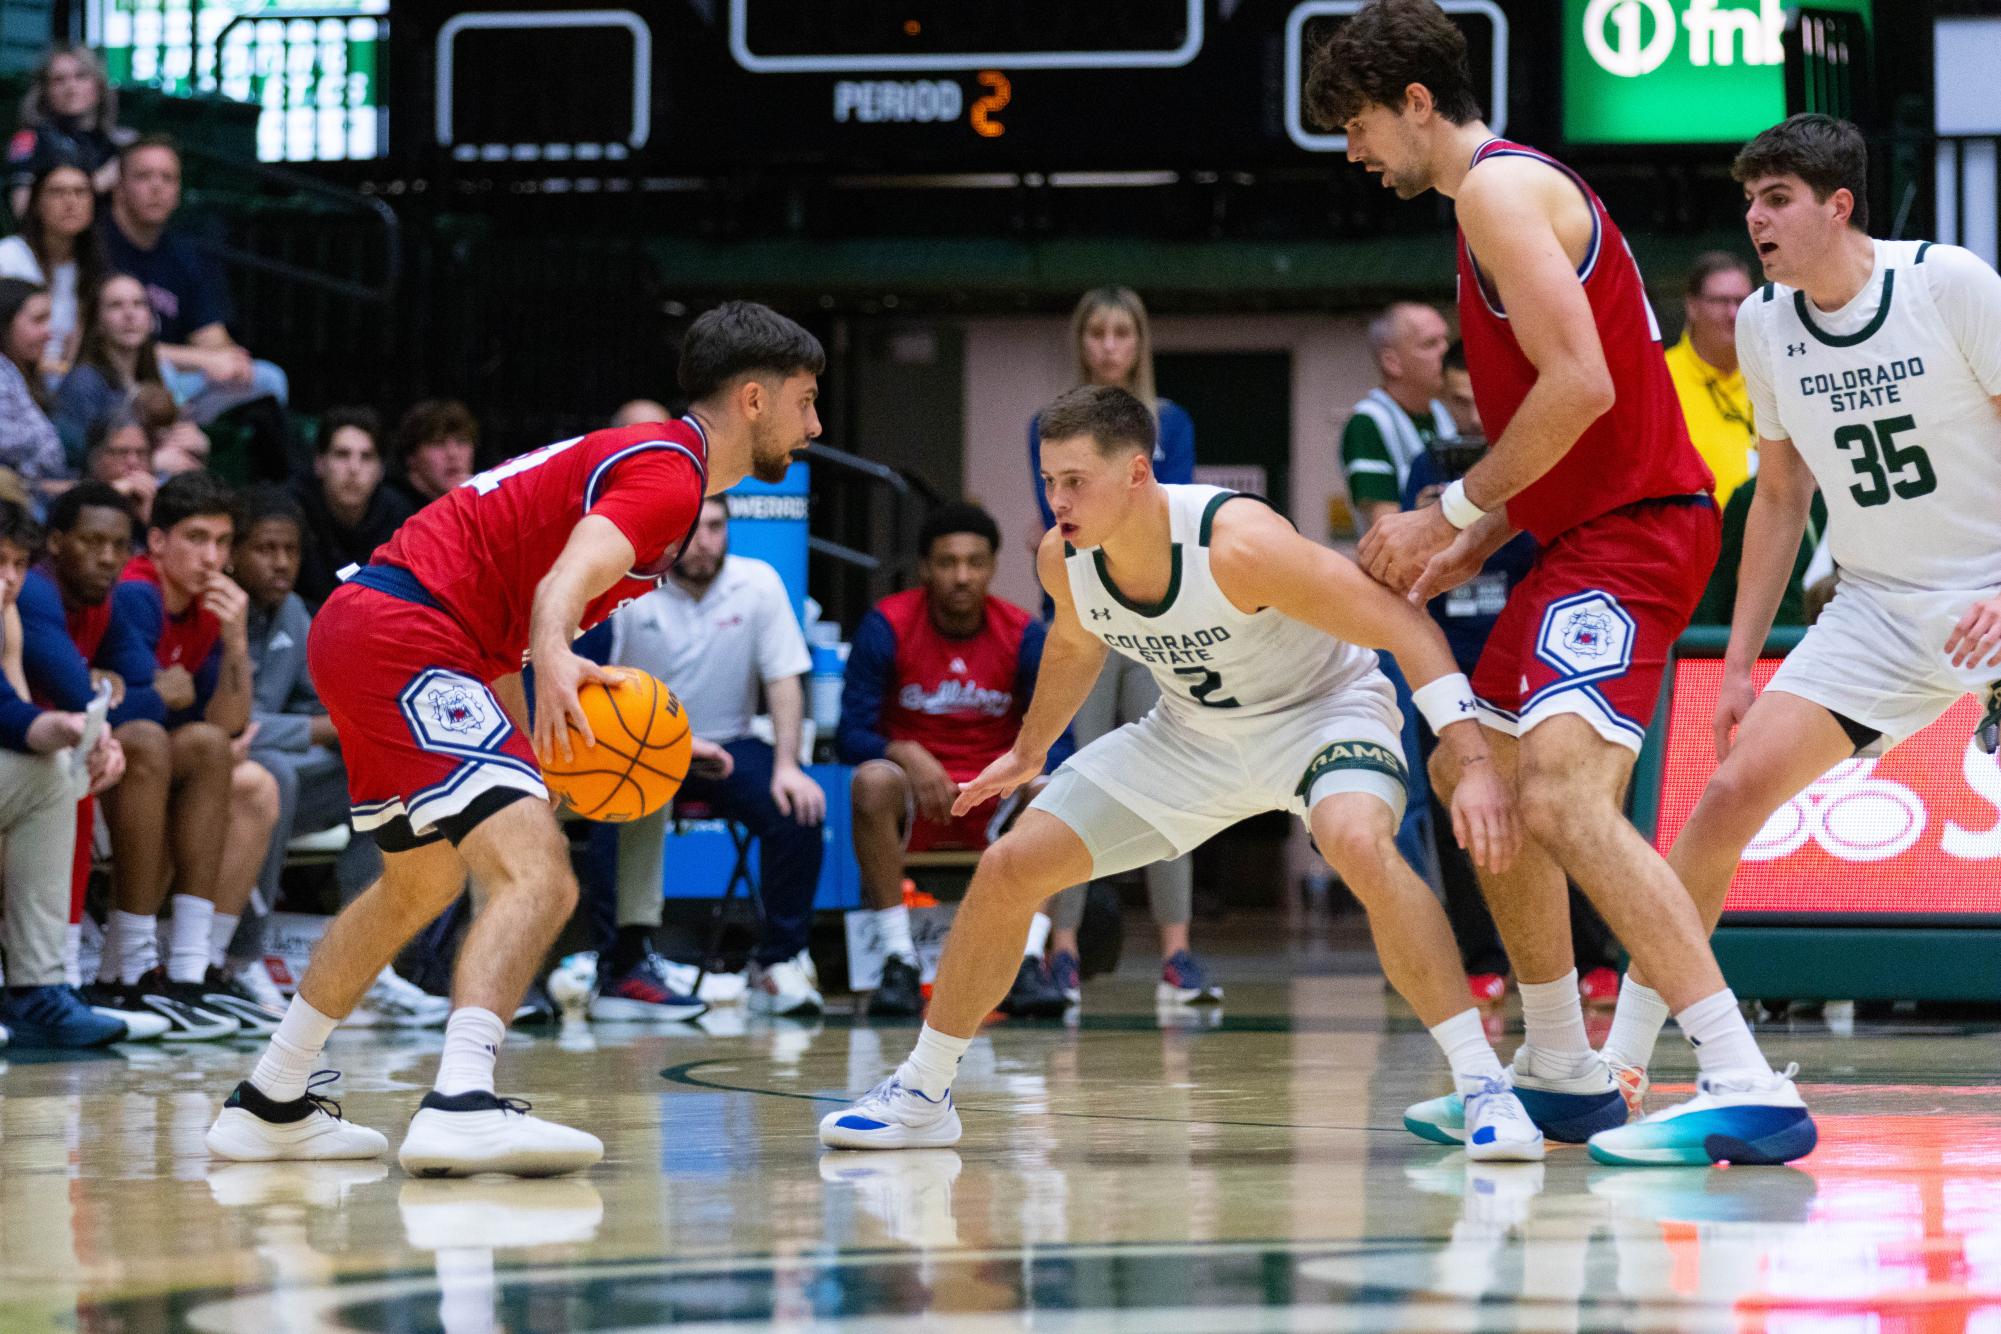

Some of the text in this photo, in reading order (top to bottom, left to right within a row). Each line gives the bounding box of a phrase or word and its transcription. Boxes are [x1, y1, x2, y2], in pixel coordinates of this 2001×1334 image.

[833, 69, 1012, 137] PERIOD 2
[1800, 356, 1925, 396] COLORADO
[1830, 384, 1902, 413] STATE
[1834, 413, 1938, 508] 35
[1103, 625, 1231, 651] COLORADO
[1139, 649, 1214, 665] STATE
[1172, 665, 1242, 708] 2
[1311, 744, 1399, 772] RAMS
